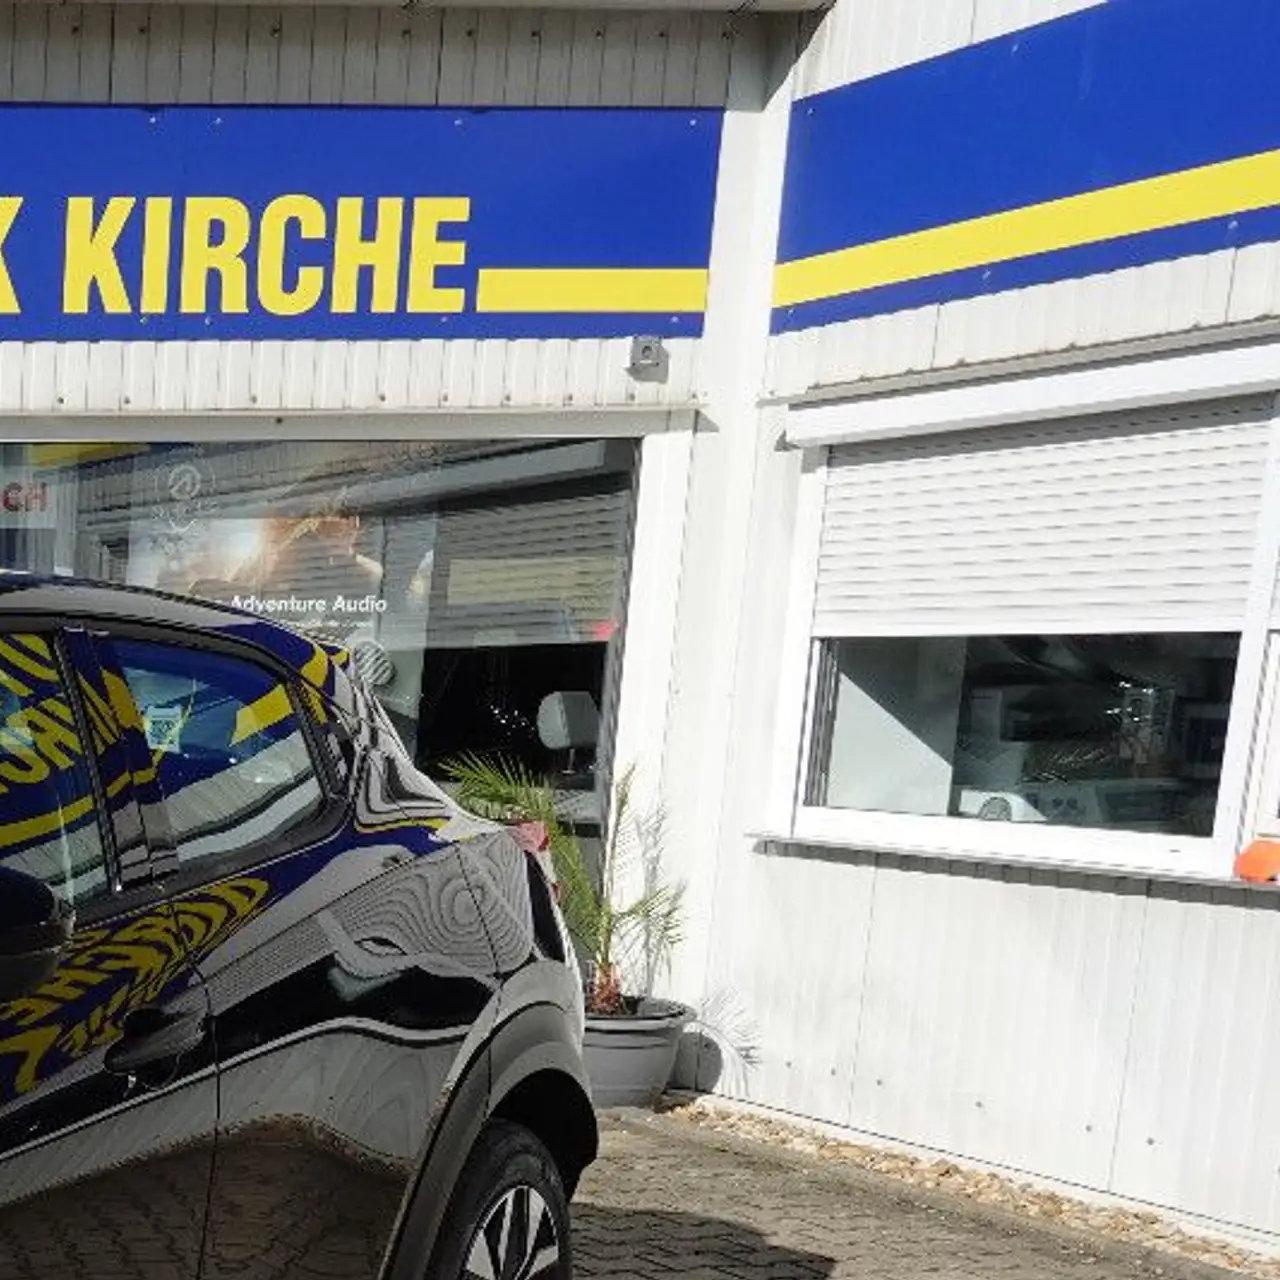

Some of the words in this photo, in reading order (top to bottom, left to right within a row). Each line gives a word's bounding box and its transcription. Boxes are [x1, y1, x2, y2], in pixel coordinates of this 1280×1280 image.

[62, 195, 472, 315] KIRCHE
[230, 594, 327, 614] Adventure
[332, 594, 388, 613] Audio
